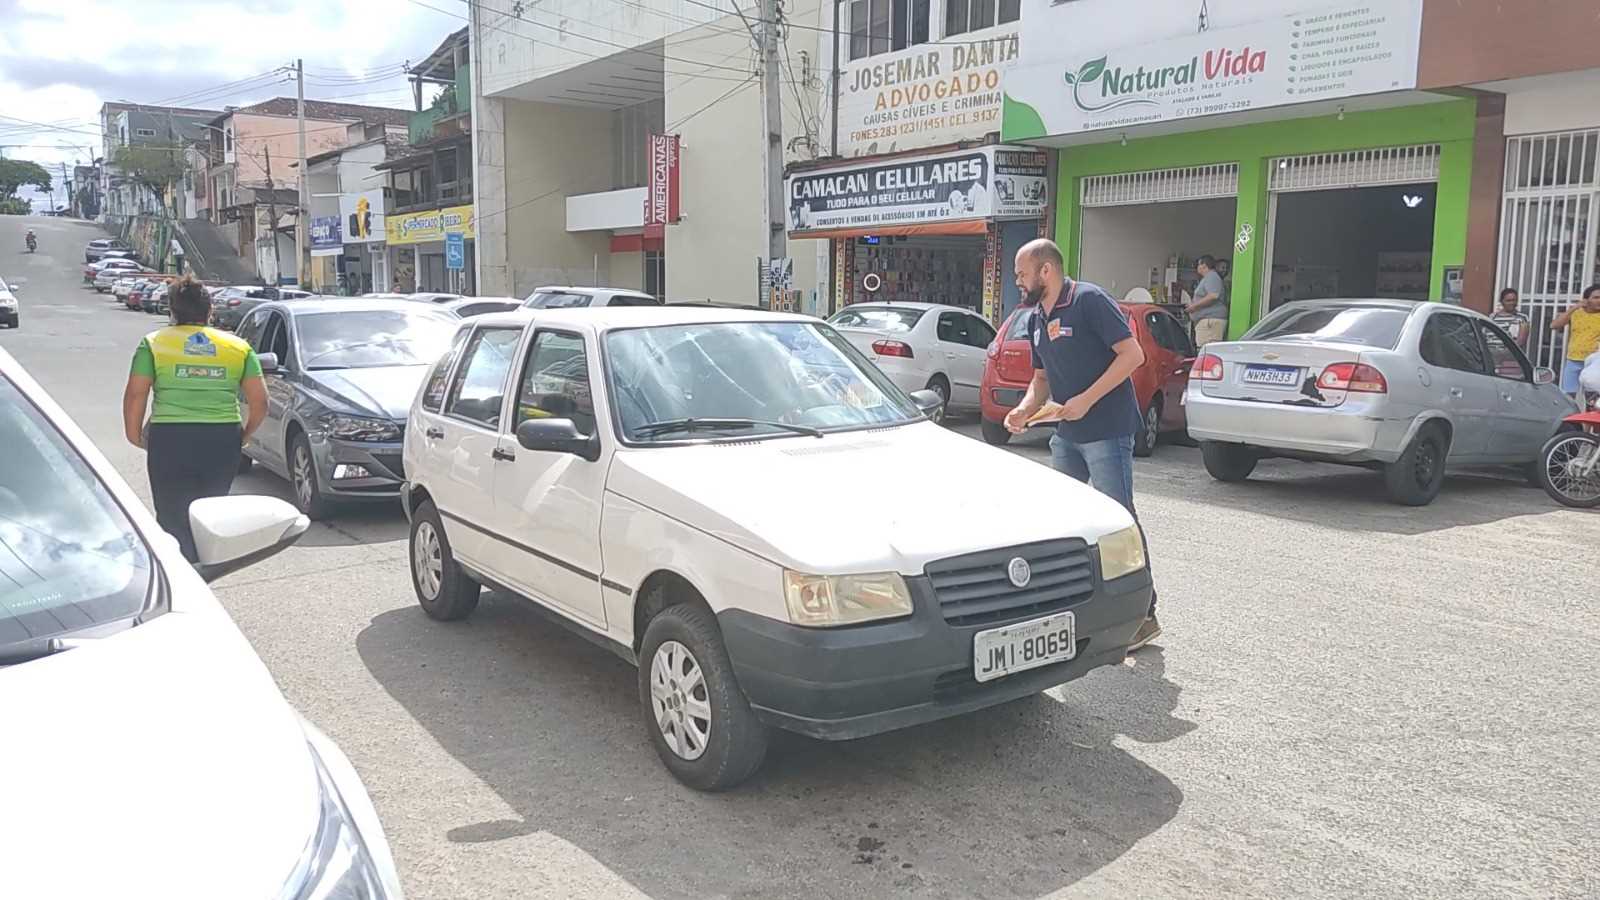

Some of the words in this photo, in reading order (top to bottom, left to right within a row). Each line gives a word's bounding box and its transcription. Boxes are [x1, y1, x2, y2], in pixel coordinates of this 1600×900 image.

[850, 51, 940, 93] JOSEMAR
[952, 32, 1020, 72] DANTA
[1102, 56, 1198, 97] Natural
[1204, 47, 1266, 80] Vida
[874, 69, 999, 111] ADVOGADO
[1147, 87, 1195, 99] Produtos
[1201, 77, 1254, 91] Naturais
[864, 109, 899, 126] CAUSAS
[902, 102, 936, 120] CÍVEIS
[941, 101, 948, 112] E
[972, 108, 999, 122] 9137
[656, 136, 666, 223] AMERICANAS
[793, 173, 868, 199] CAMACAN
[875, 158, 982, 190] CELULARES
[826, 199, 847, 209] TUDO
[848, 196, 870, 207] PARA
[871, 195, 878, 205] O
[879, 193, 895, 204] SEU
[896, 189, 936, 202] CELULAR
